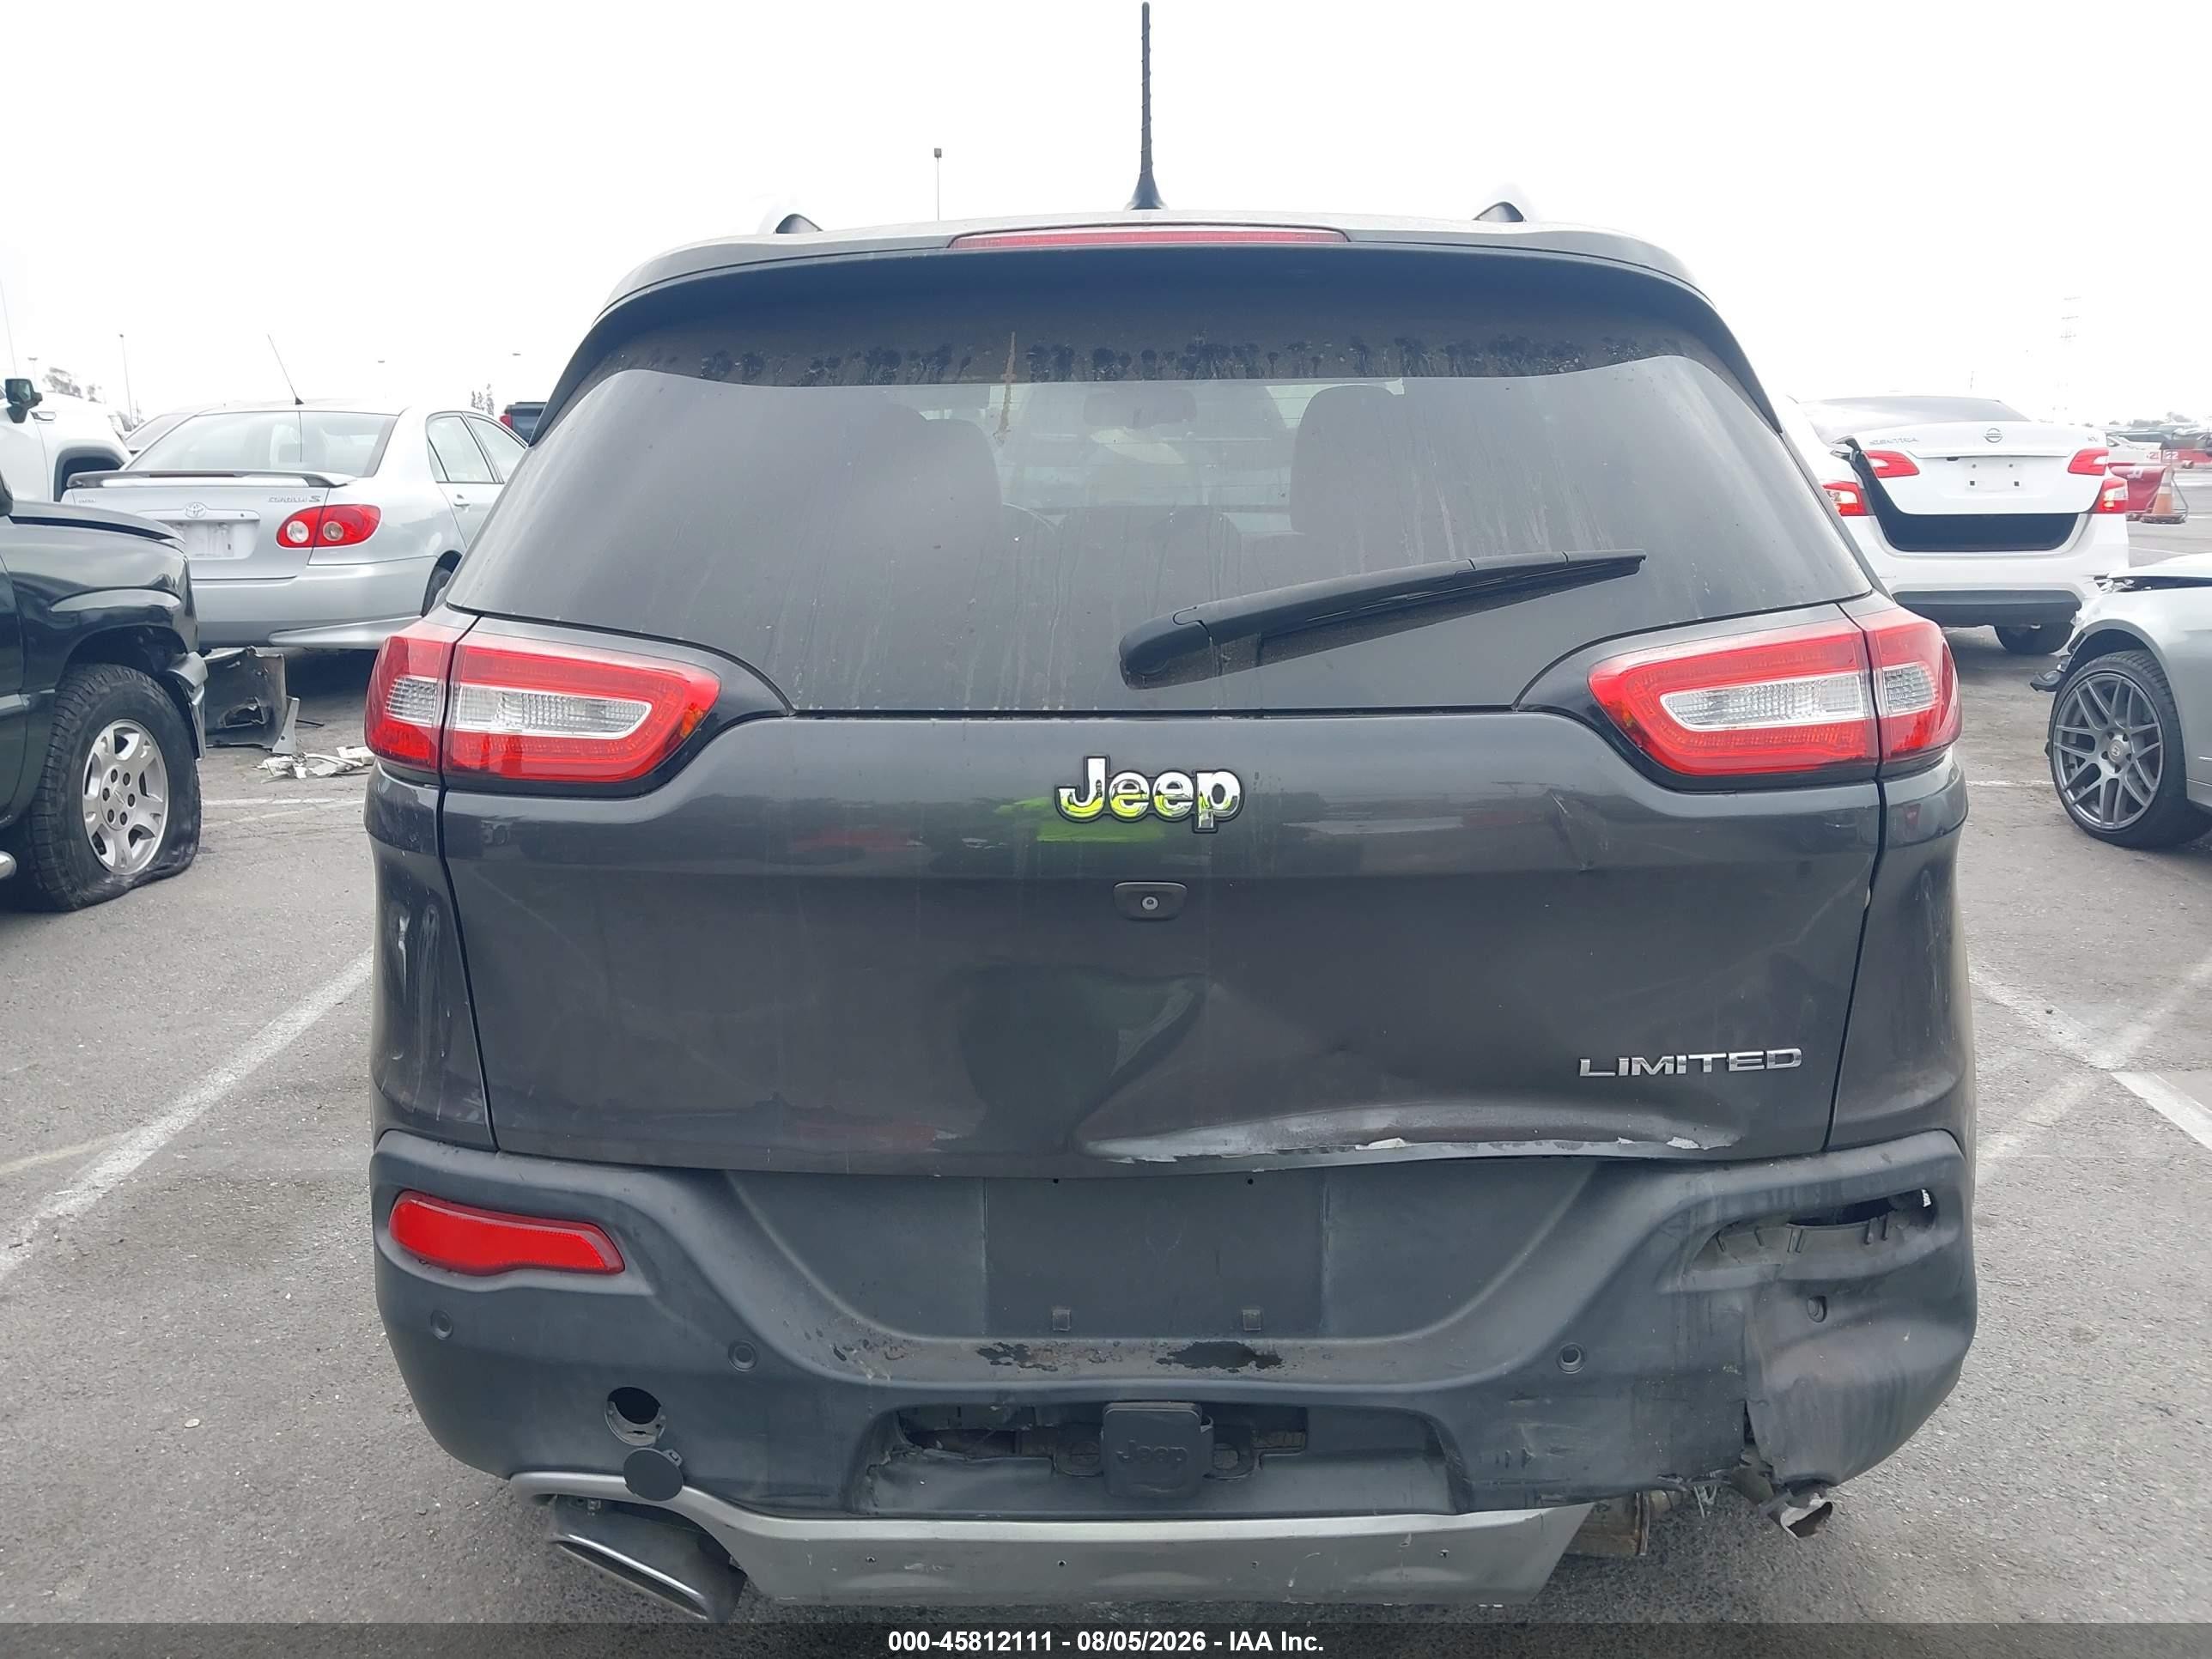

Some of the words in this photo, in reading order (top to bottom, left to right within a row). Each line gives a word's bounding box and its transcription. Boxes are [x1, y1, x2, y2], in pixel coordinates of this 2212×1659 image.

[1056, 756, 1243, 832] Jeep
[1578, 1048, 1803, 1077] LIMITED
[1116, 1439, 1188, 1474] Jeep
